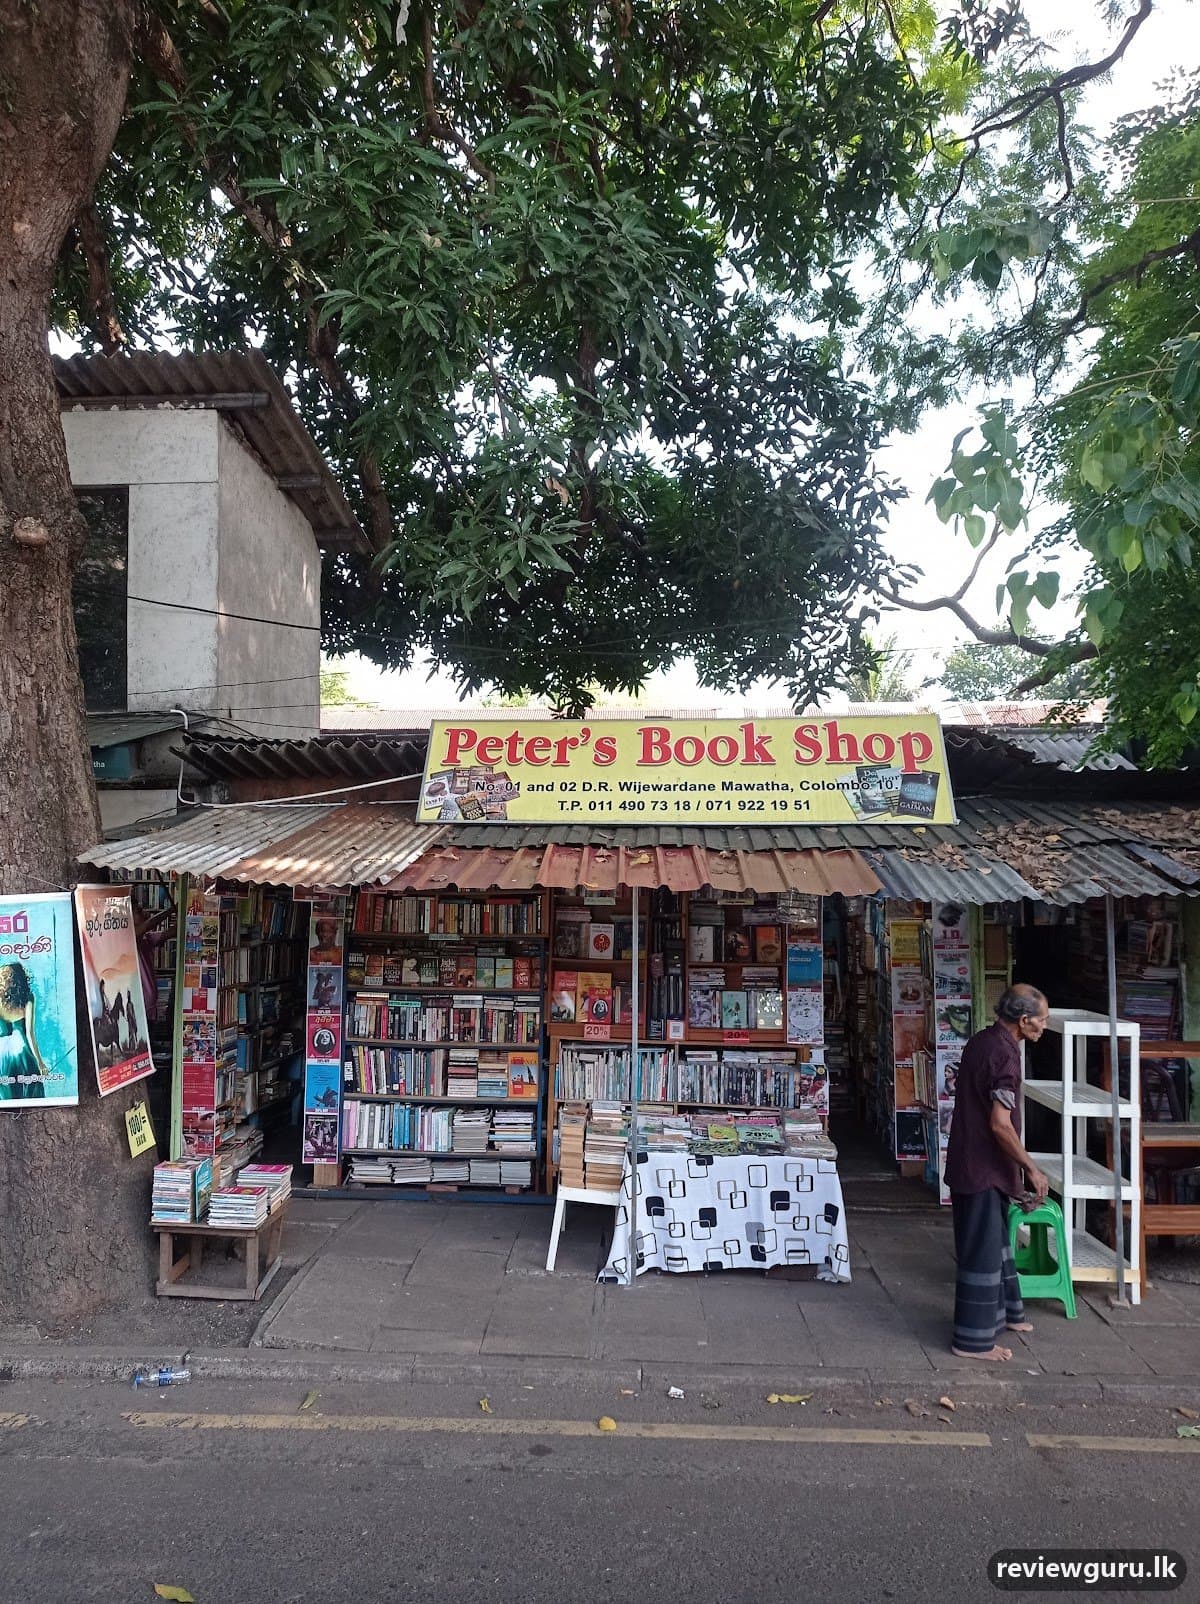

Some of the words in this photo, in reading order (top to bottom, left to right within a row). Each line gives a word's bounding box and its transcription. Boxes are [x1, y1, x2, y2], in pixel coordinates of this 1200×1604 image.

[441, 727, 618, 767] Peter's
[637, 723, 776, 766] Book
[794, 721, 933, 773] Shop
[475, 781, 499, 792] No.
[505, 781, 521, 792] 01
[526, 781, 555, 792] and
[559, 781, 577, 792] 02
[582, 781, 613, 792] D.R.
[618, 780, 717, 794] Wijewardane
[721, 780, 794, 794] Mawatha,
[799, 780, 870, 792] Colombo
[876, 779, 899, 791] 10.
[557, 800, 583, 811] T.P.
[588, 800, 612, 811] 011
[615, 800, 645, 811] 490
[650, 800, 668, 811] 73
[674, 800, 691, 811] 18
[695, 800, 701, 811] /
[705, 800, 731, 811] 071
[737, 800, 765, 811] 922
[770, 800, 788, 811] 19
[793, 800, 810, 811] 51
[899, 801, 932, 813] GAIMAN
[586, 1025, 608, 1036] 20%
[727, 1031, 749, 1039] 20%
